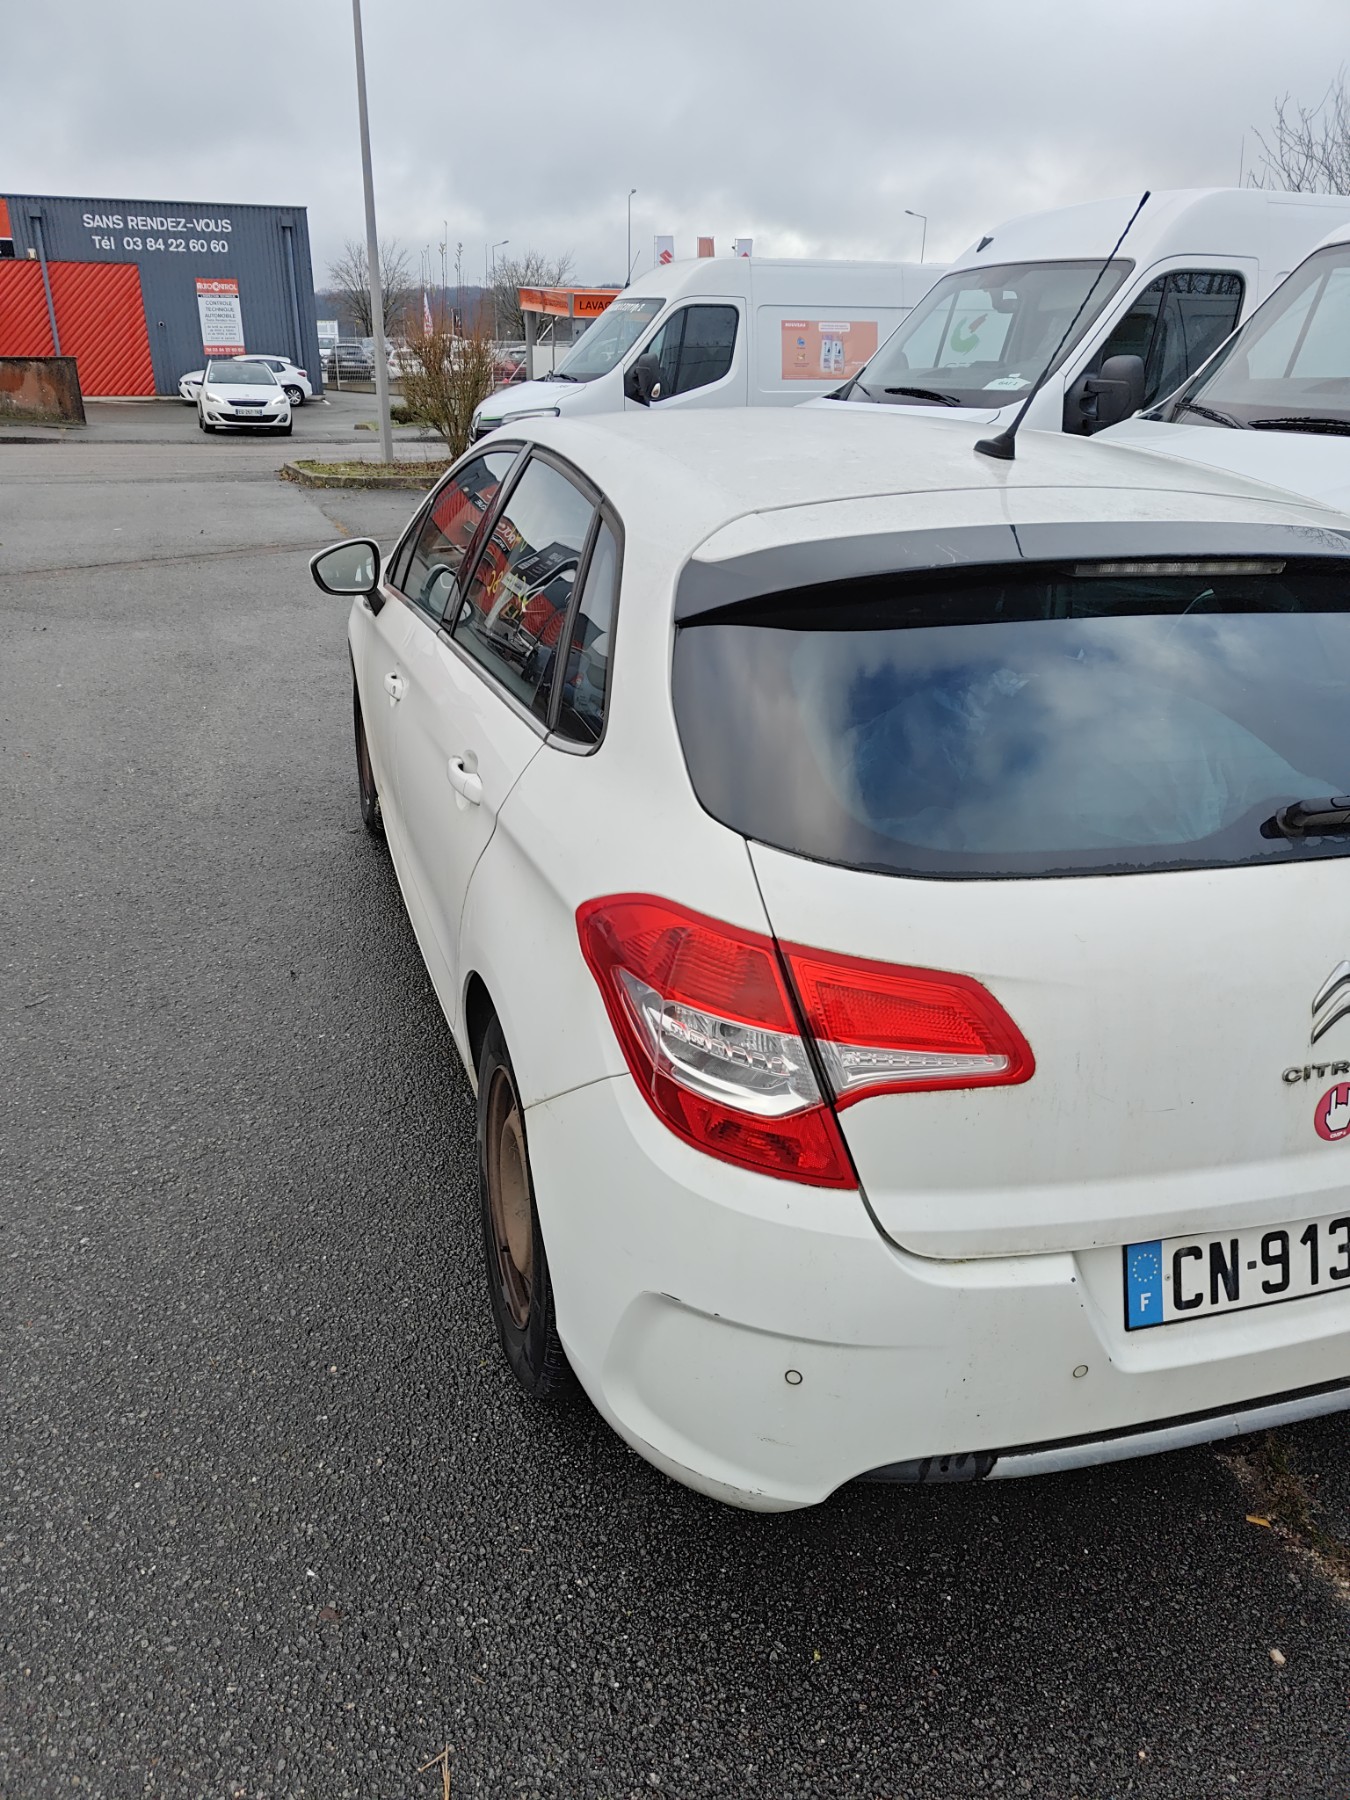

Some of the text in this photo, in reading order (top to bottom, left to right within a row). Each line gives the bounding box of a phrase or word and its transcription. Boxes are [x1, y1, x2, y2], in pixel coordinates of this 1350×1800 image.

[82, 213, 232, 232] SANS RENDEZ-VOUS
[92, 235, 229, 253] Tél 03 84 22 60 60
[1140, 1292, 1151, 1312] F
